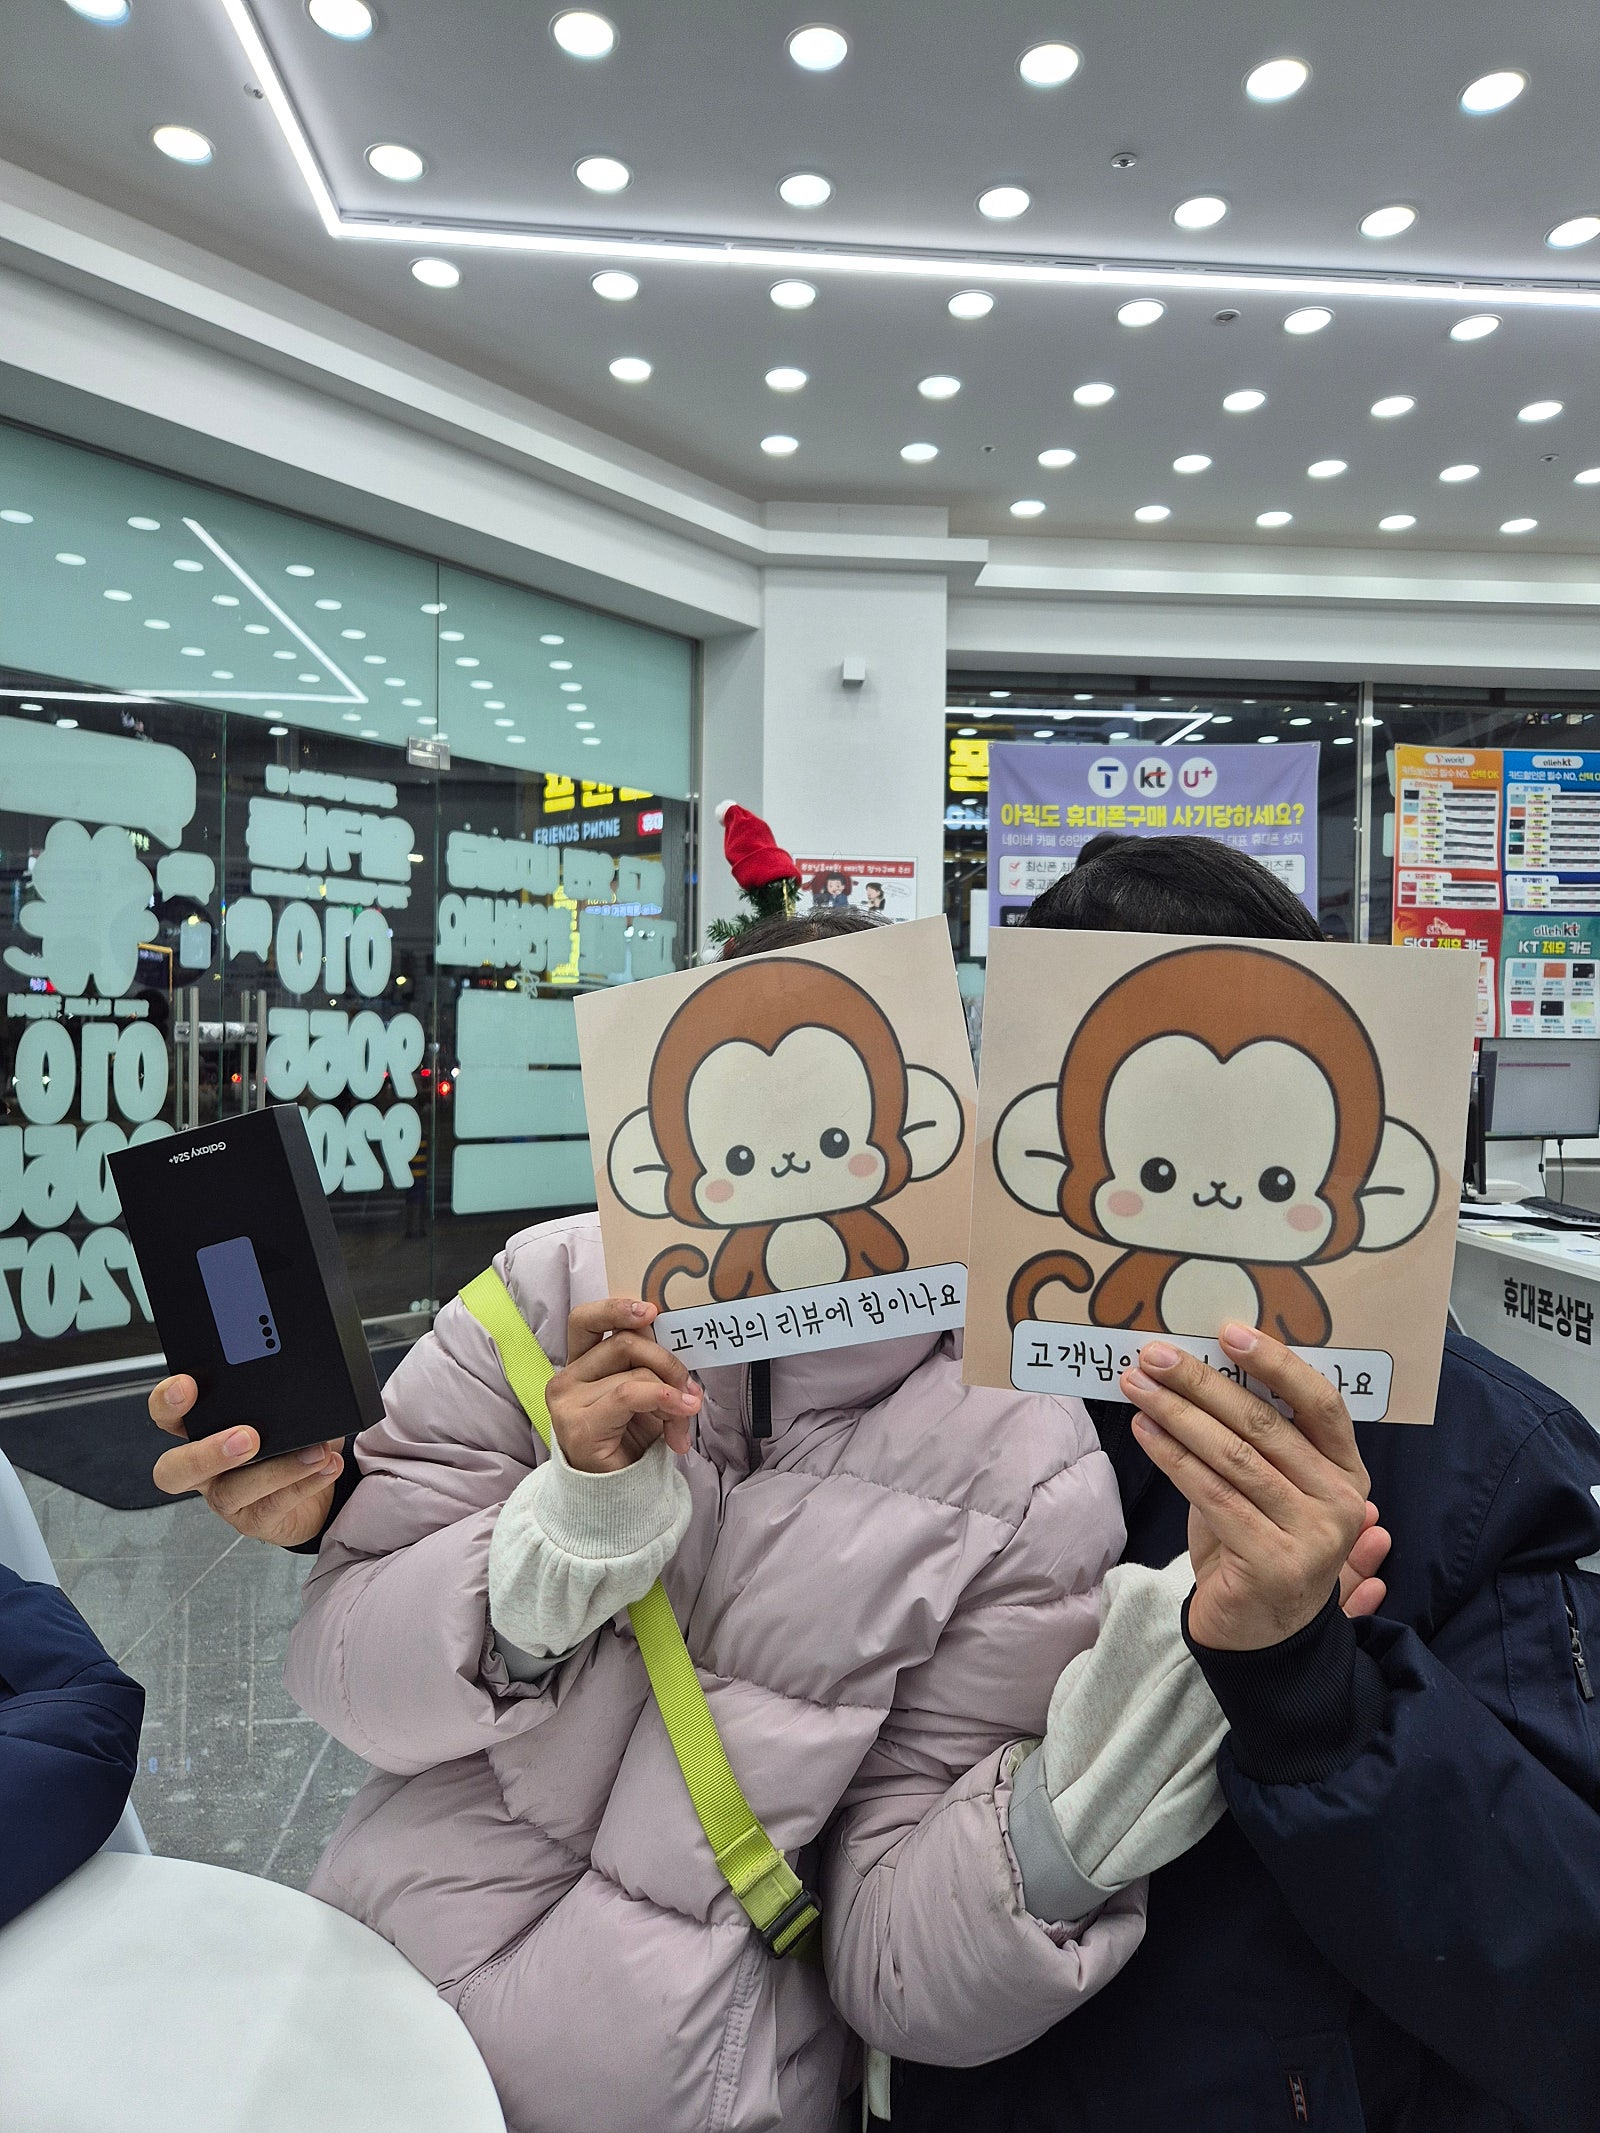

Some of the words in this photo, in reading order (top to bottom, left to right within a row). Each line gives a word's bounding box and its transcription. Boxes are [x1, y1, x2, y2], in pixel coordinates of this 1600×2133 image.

[1097, 766, 1119, 789] T
[1140, 767, 1166, 788] kt
[1183, 766, 1212, 788] U+
[1488, 770, 1499, 779] OK
[1001, 803, 1060, 828] 아직도
[1066, 804, 1167, 828] 휴대폰구매
[1172, 803, 1305, 828] 사기당하세요?
[533, 822, 579, 845] FRIENDS
[581, 817, 620, 840] PHONE
[1002, 834, 1033, 847] 네이버
[1036, 834, 1056, 847] 카페
[1251, 832, 1280, 846] 휴대폰
[1283, 832, 1303, 846] 성지
[1025, 861, 1057, 872] 최신폰
[1404, 938, 1436, 949] SKT
[1519, 941, 1539, 954] KT
[1541, 940, 1566, 954] 제휴
[1569, 941, 1591, 954] 카드
[168, 1151, 191, 1164] S24+
[191, 1141, 227, 1158] Galaxy
[1503, 1276, 1594, 1346] 휴대폰상담
[670, 1312, 769, 1352] 고객님의
[775, 1297, 854, 1338] 리뷰에
